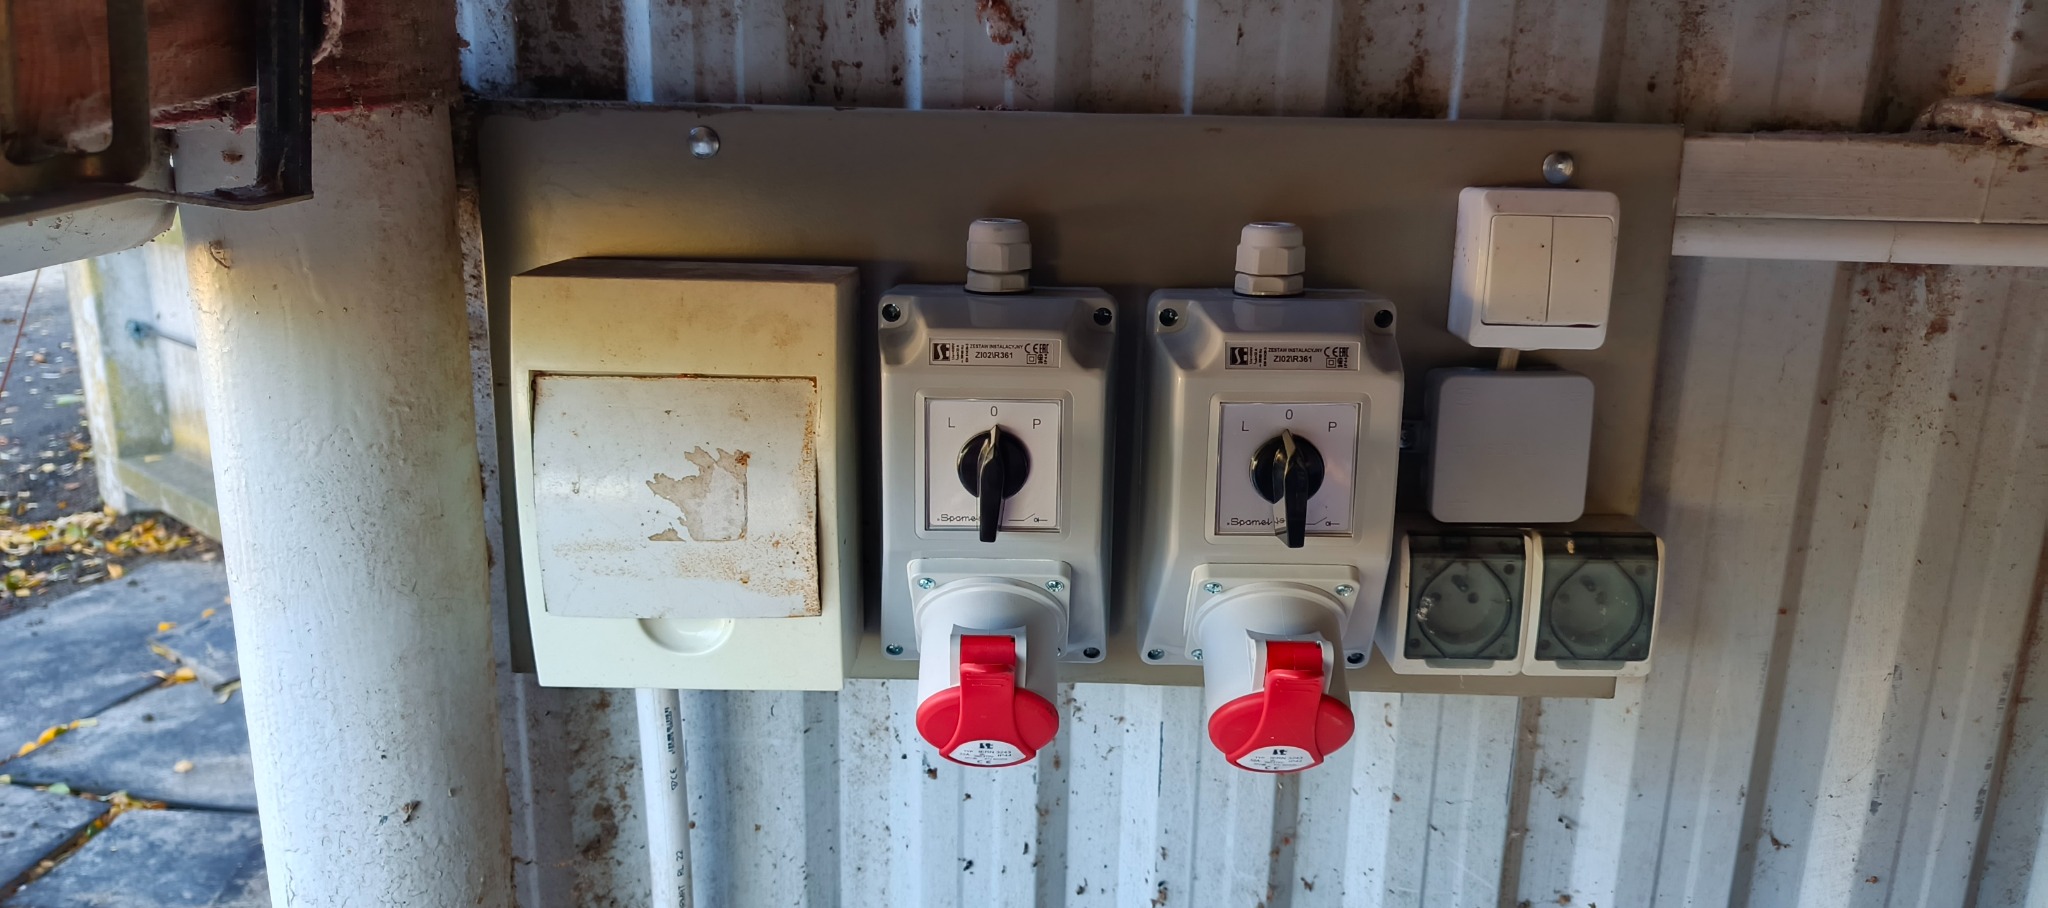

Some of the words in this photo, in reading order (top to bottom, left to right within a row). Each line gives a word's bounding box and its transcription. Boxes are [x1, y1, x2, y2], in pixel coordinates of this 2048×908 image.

[948, 417, 956, 428] L
[1032, 418, 1042, 430] P
[1241, 420, 1250, 432] L
[1328, 421, 1338, 433] P
[676, 850, 685, 862] 22
